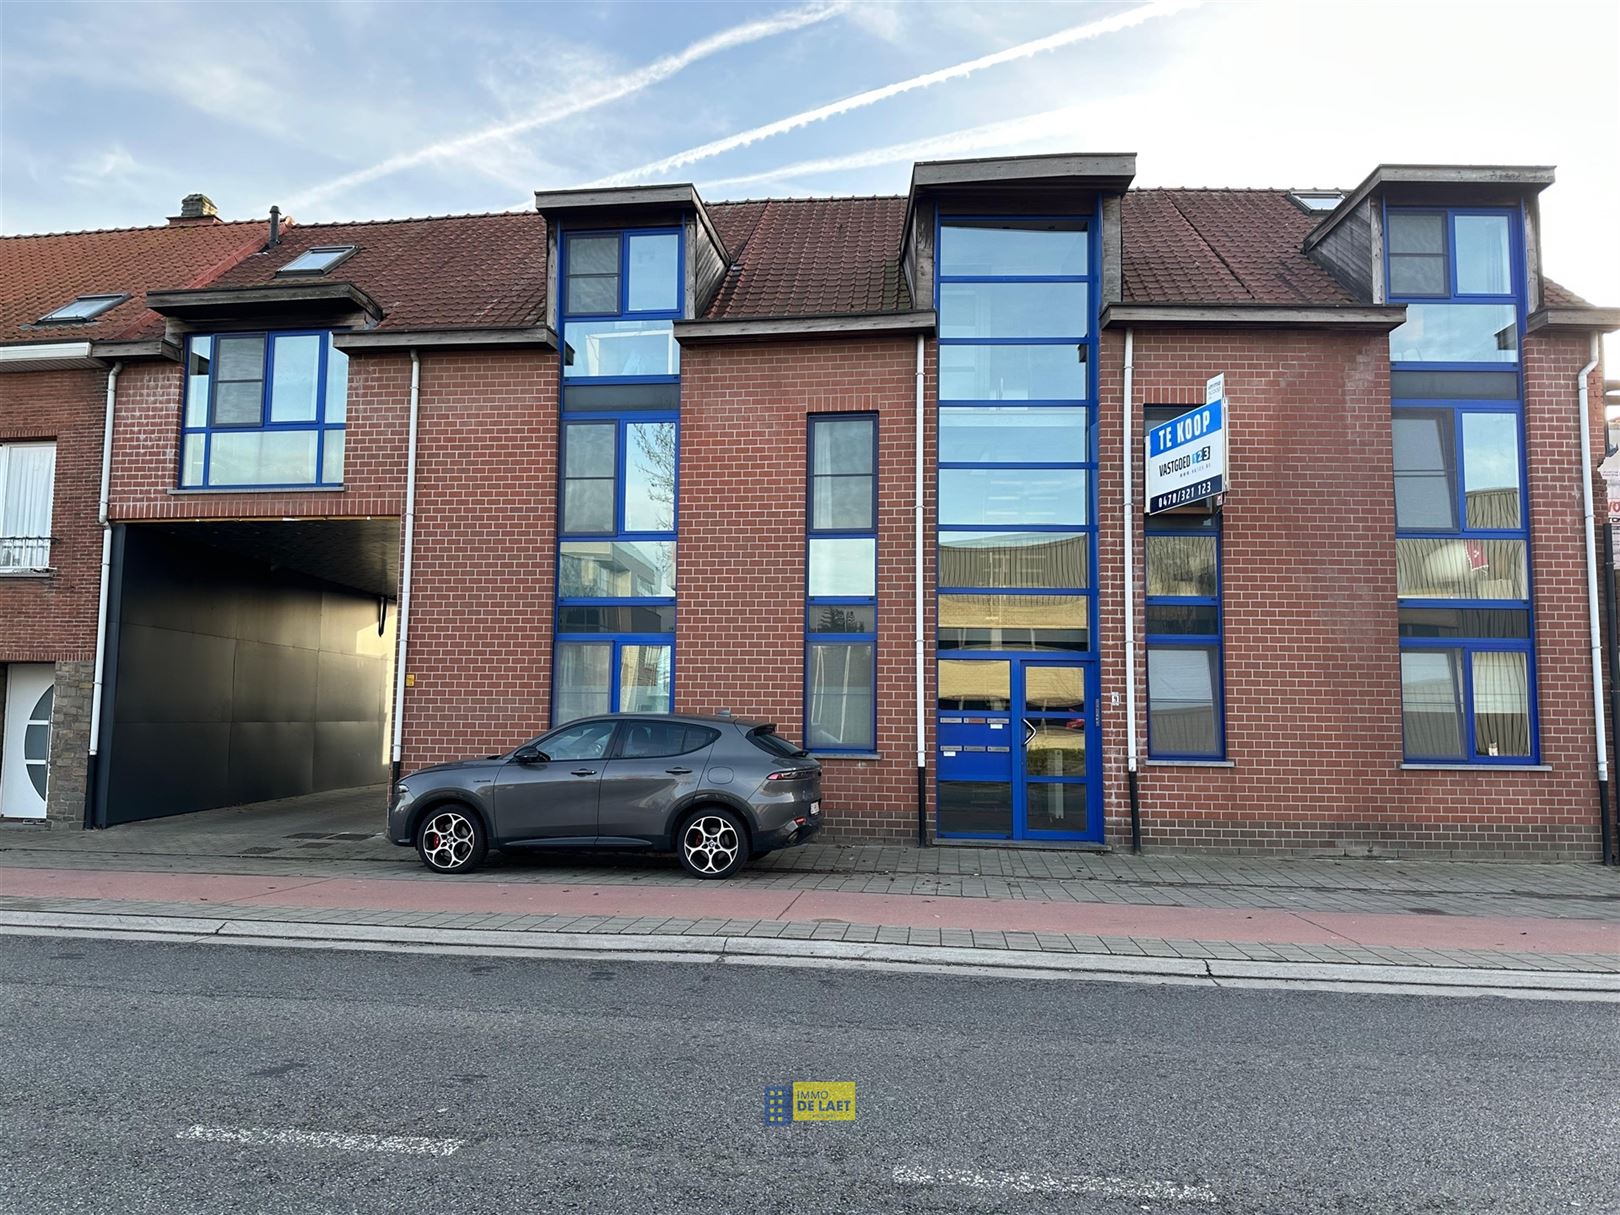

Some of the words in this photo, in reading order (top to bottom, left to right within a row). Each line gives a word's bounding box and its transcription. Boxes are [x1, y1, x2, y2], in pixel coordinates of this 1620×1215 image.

[1159, 427, 1172, 450] TE
[1177, 410, 1210, 443] KOOP
[1159, 454, 1191, 477] VASTGOED
[1193, 446, 1210, 463] 123
[1158, 486, 1194, 508] 0470/321
[1198, 482, 1211, 495] 123
